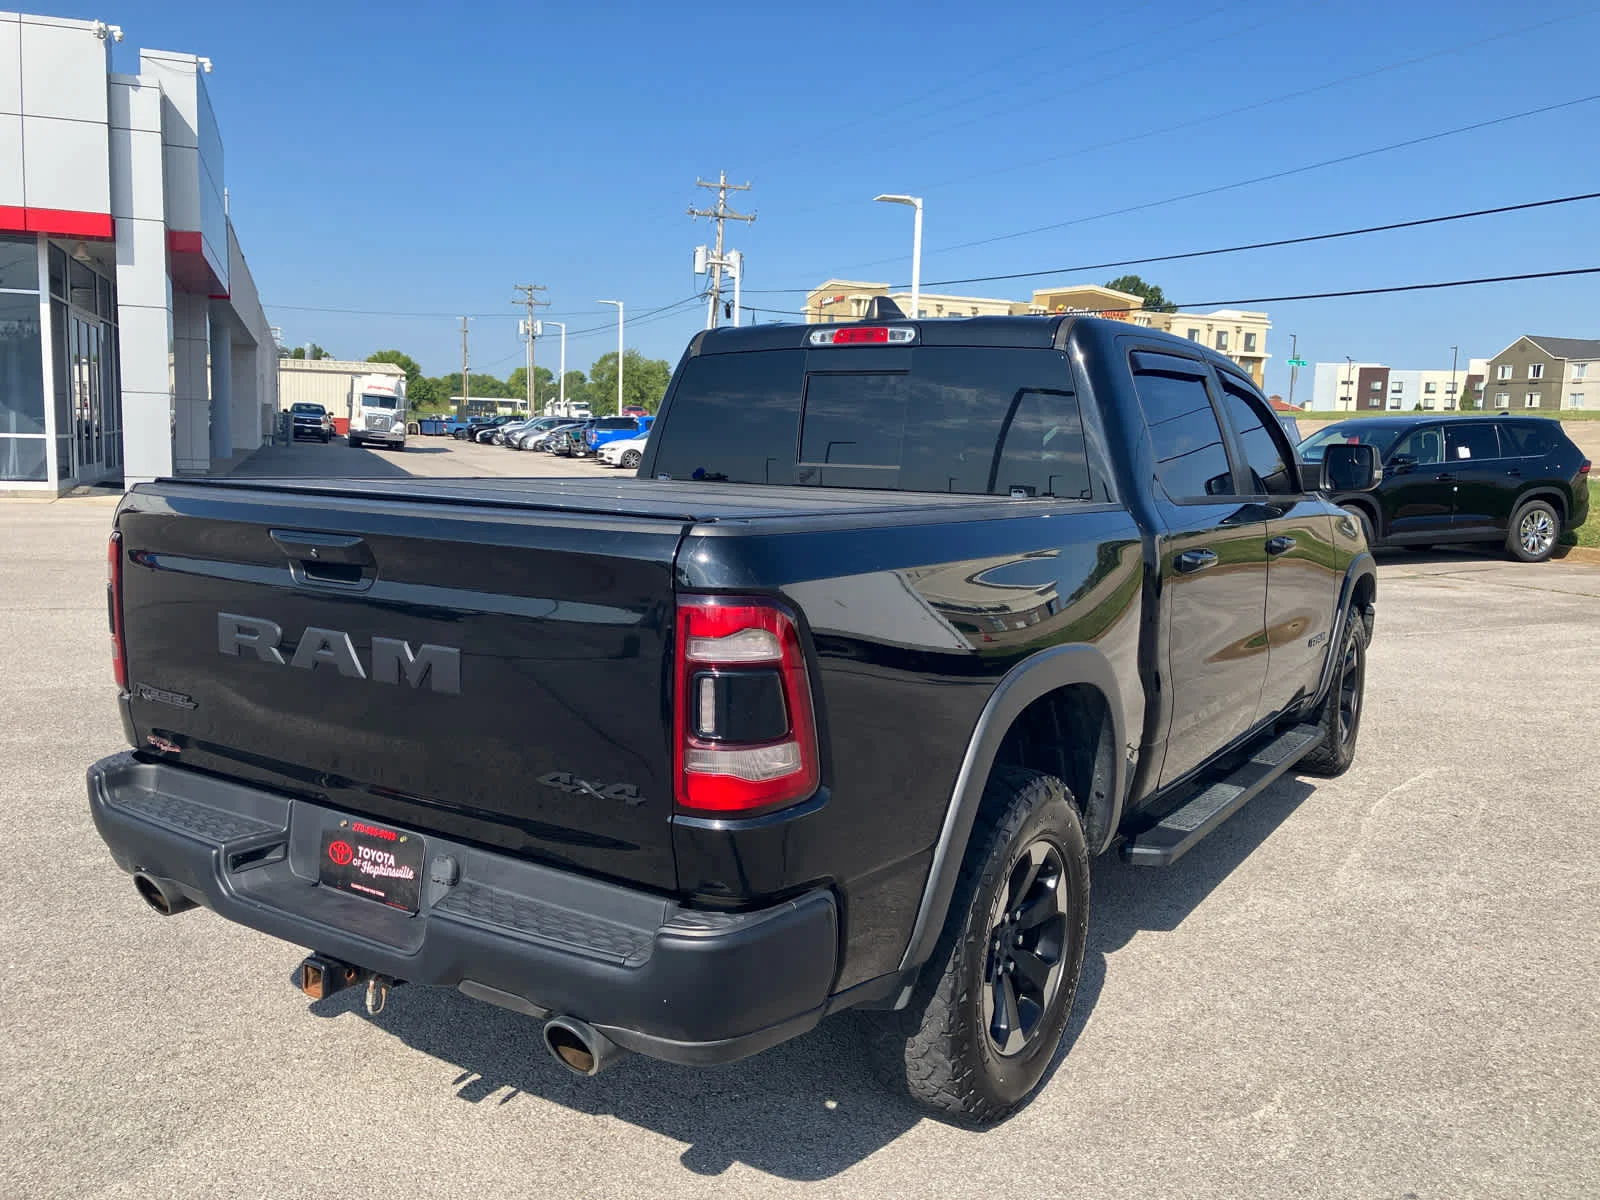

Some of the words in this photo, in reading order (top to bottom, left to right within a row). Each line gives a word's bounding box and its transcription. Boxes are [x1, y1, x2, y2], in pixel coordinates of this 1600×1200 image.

[218, 611, 461, 695] RAM
[357, 845, 395, 867] TOYOTA
[360, 861, 415, 880] Hopkinsville
